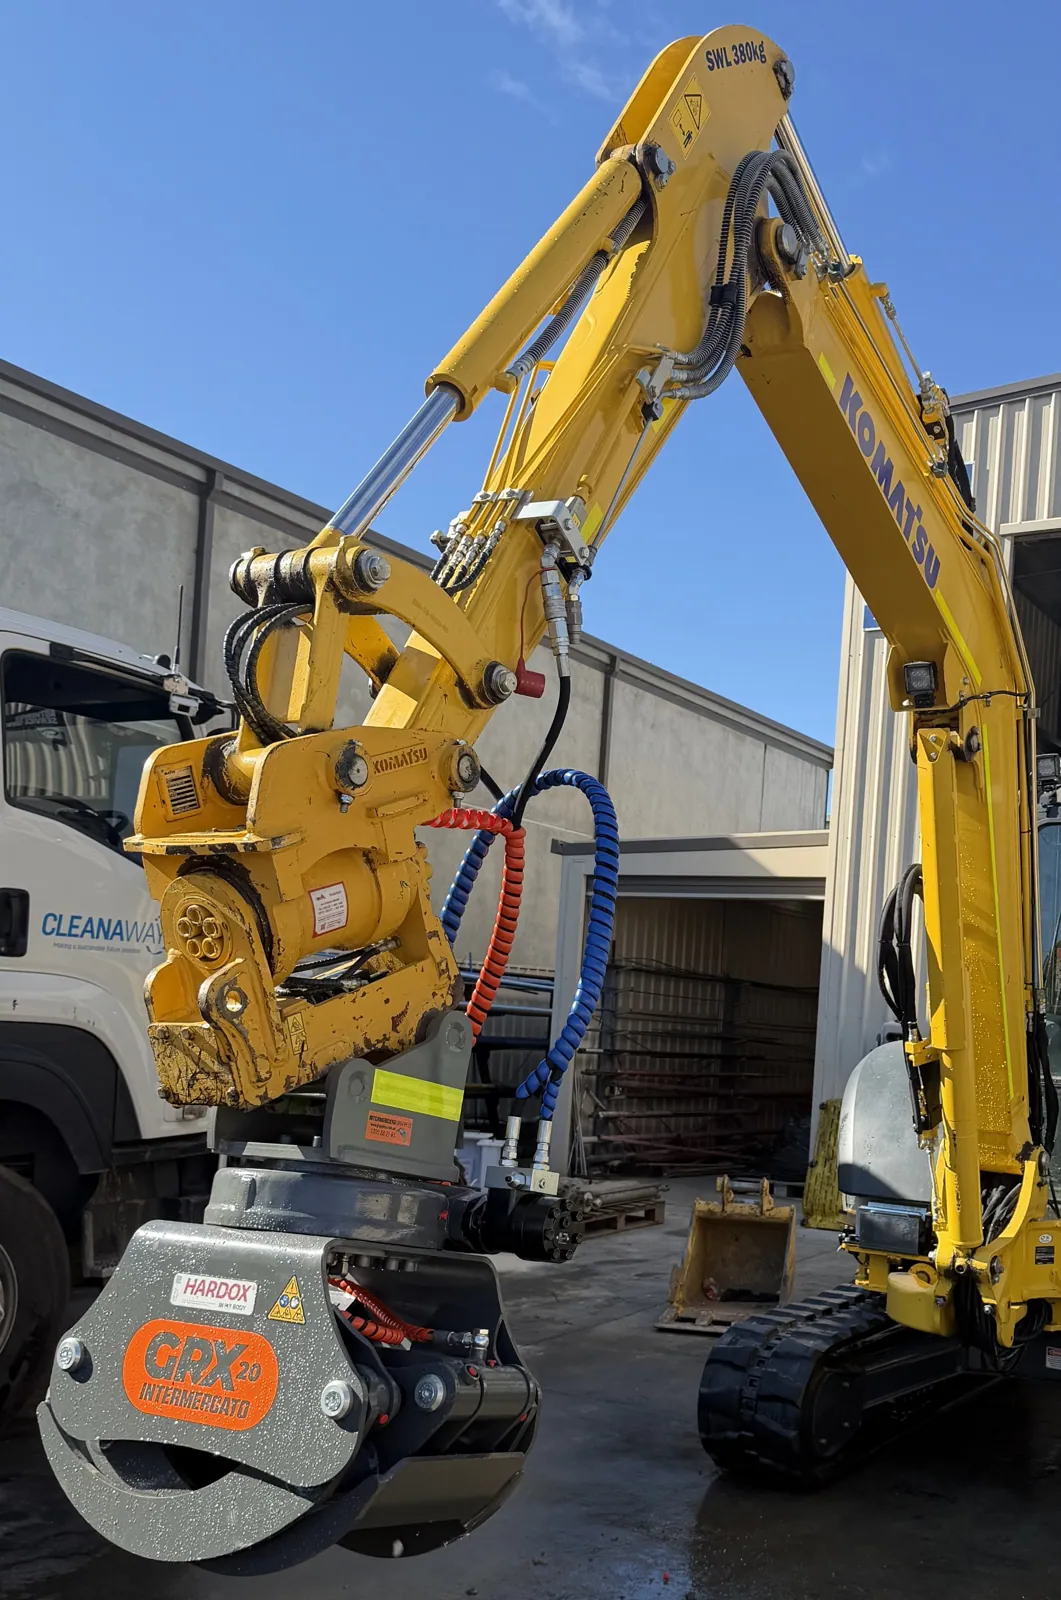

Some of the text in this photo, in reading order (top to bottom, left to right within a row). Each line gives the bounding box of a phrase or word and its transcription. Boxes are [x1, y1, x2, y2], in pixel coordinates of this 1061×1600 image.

[705, 41, 767, 71] SWL 380kg
[838, 371, 941, 589] KOMATSU
[373, 747, 428, 775] KOMATSU
[41, 912, 162, 945] CLEANAWAY
[183, 1277, 252, 1303] HARDOX
[144, 1331, 262, 1392] GRX 20
[139, 1382, 251, 1419] INTERMERCATO
